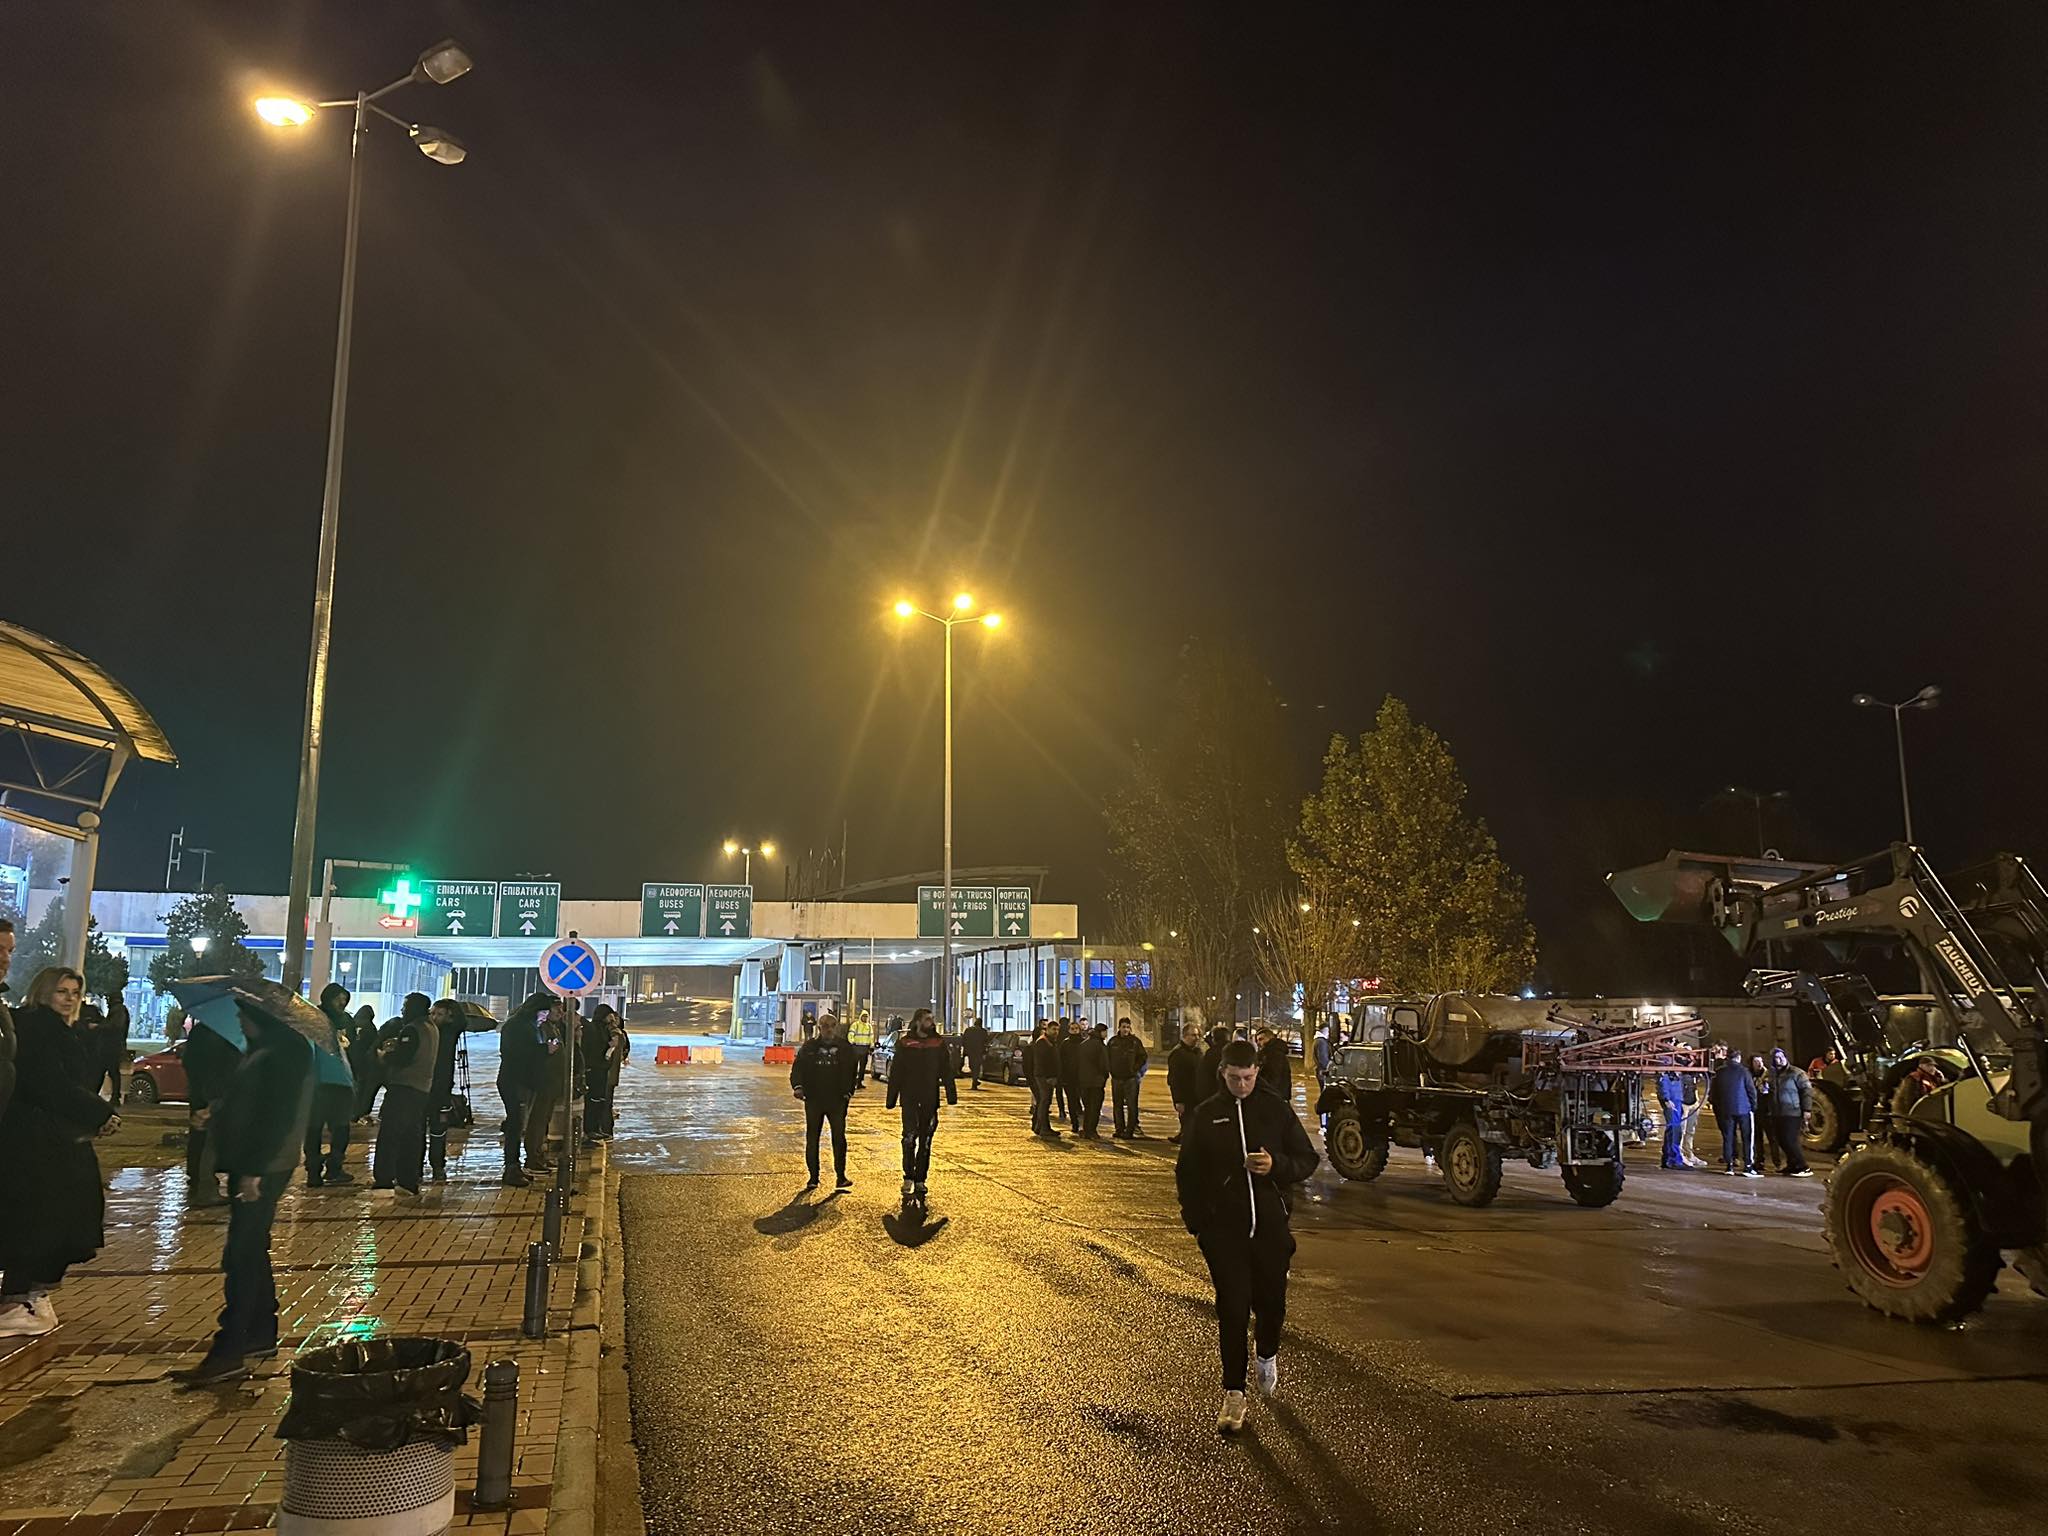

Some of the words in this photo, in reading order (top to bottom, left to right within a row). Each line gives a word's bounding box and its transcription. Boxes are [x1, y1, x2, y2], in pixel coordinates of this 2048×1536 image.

[436, 885, 480, 896] ΕΠΙΒΑΤΙΚΑ
[502, 886, 545, 896] ΕΠΙΒΑΤΙΚΑ
[659, 888, 701, 897] ΛΕΩΦΟΡΕΙΑ
[967, 891, 993, 899] TRUCKS
[999, 892, 1028, 900] ΦΟΡΤΗΓΑ
[436, 898, 460, 907] CARS
[518, 899, 541, 908] CARS
[659, 899, 684, 909] BUSES
[715, 901, 740, 910] BUSES
[963, 902, 988, 910] FRIGOS
[1000, 902, 1026, 911] TRUCKS
[1815, 906, 1859, 925] Prestige
[1938, 938, 1986, 996] FAUCHEUX
